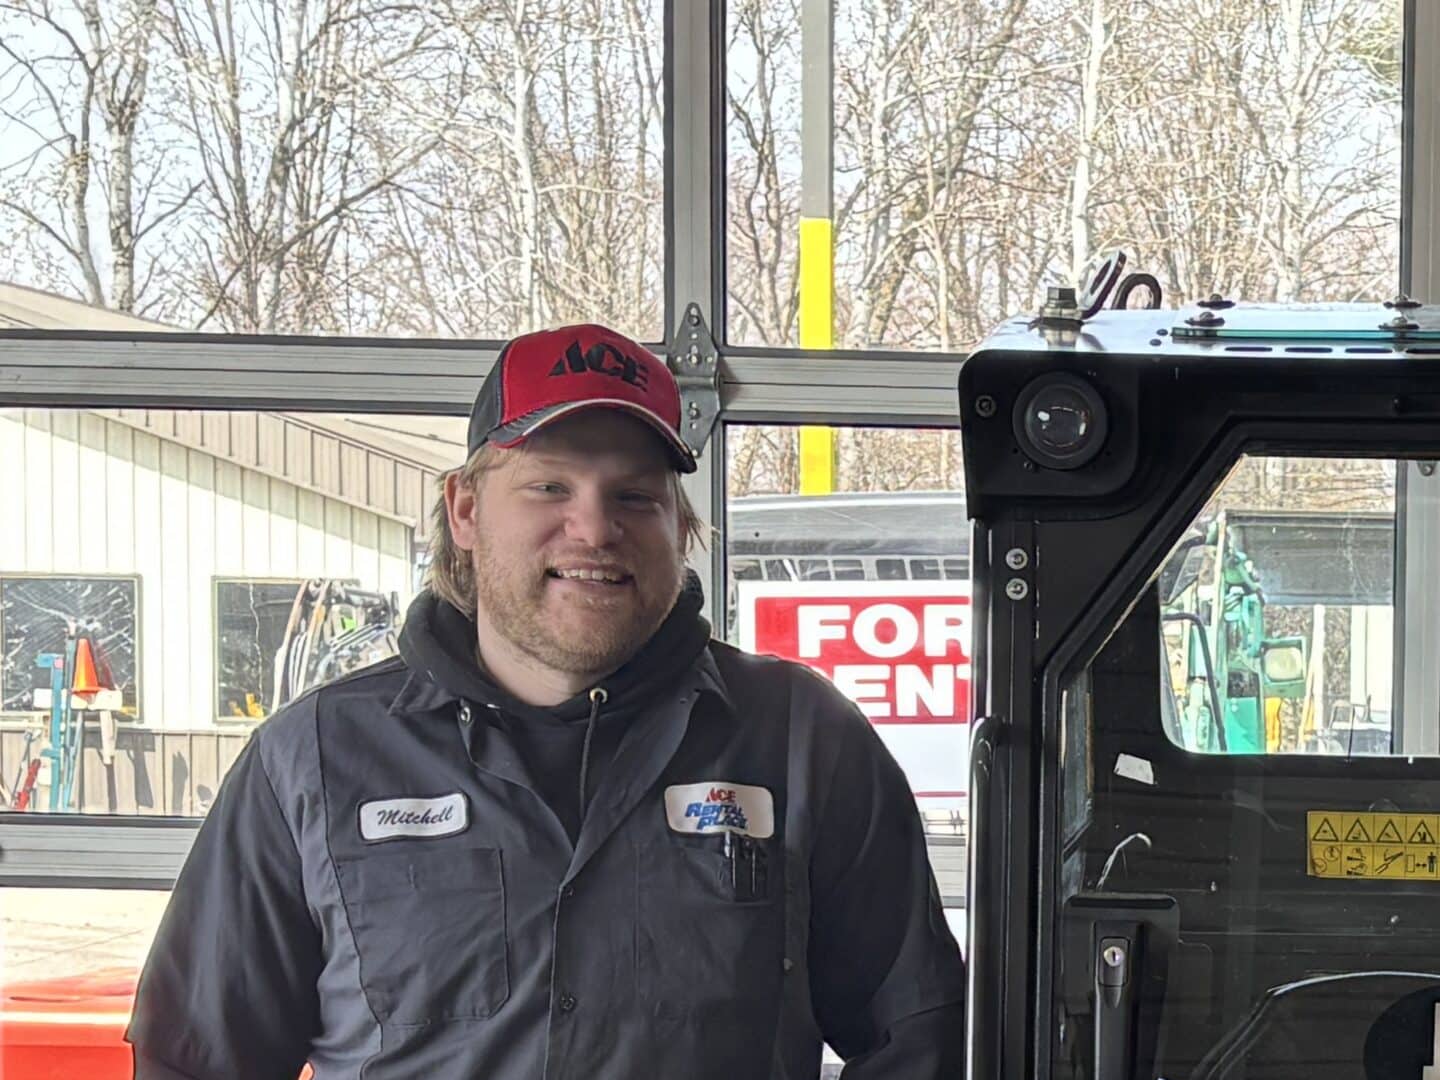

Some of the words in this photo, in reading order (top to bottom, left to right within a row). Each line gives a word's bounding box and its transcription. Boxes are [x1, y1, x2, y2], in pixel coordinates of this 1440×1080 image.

[548, 339, 650, 391] ACE
[797, 603, 969, 660] FOR
[818, 664, 970, 718] EN
[685, 802, 743, 818] RENTAL
[706, 788, 736, 803] ACE
[377, 805, 453, 826] Mitchell
